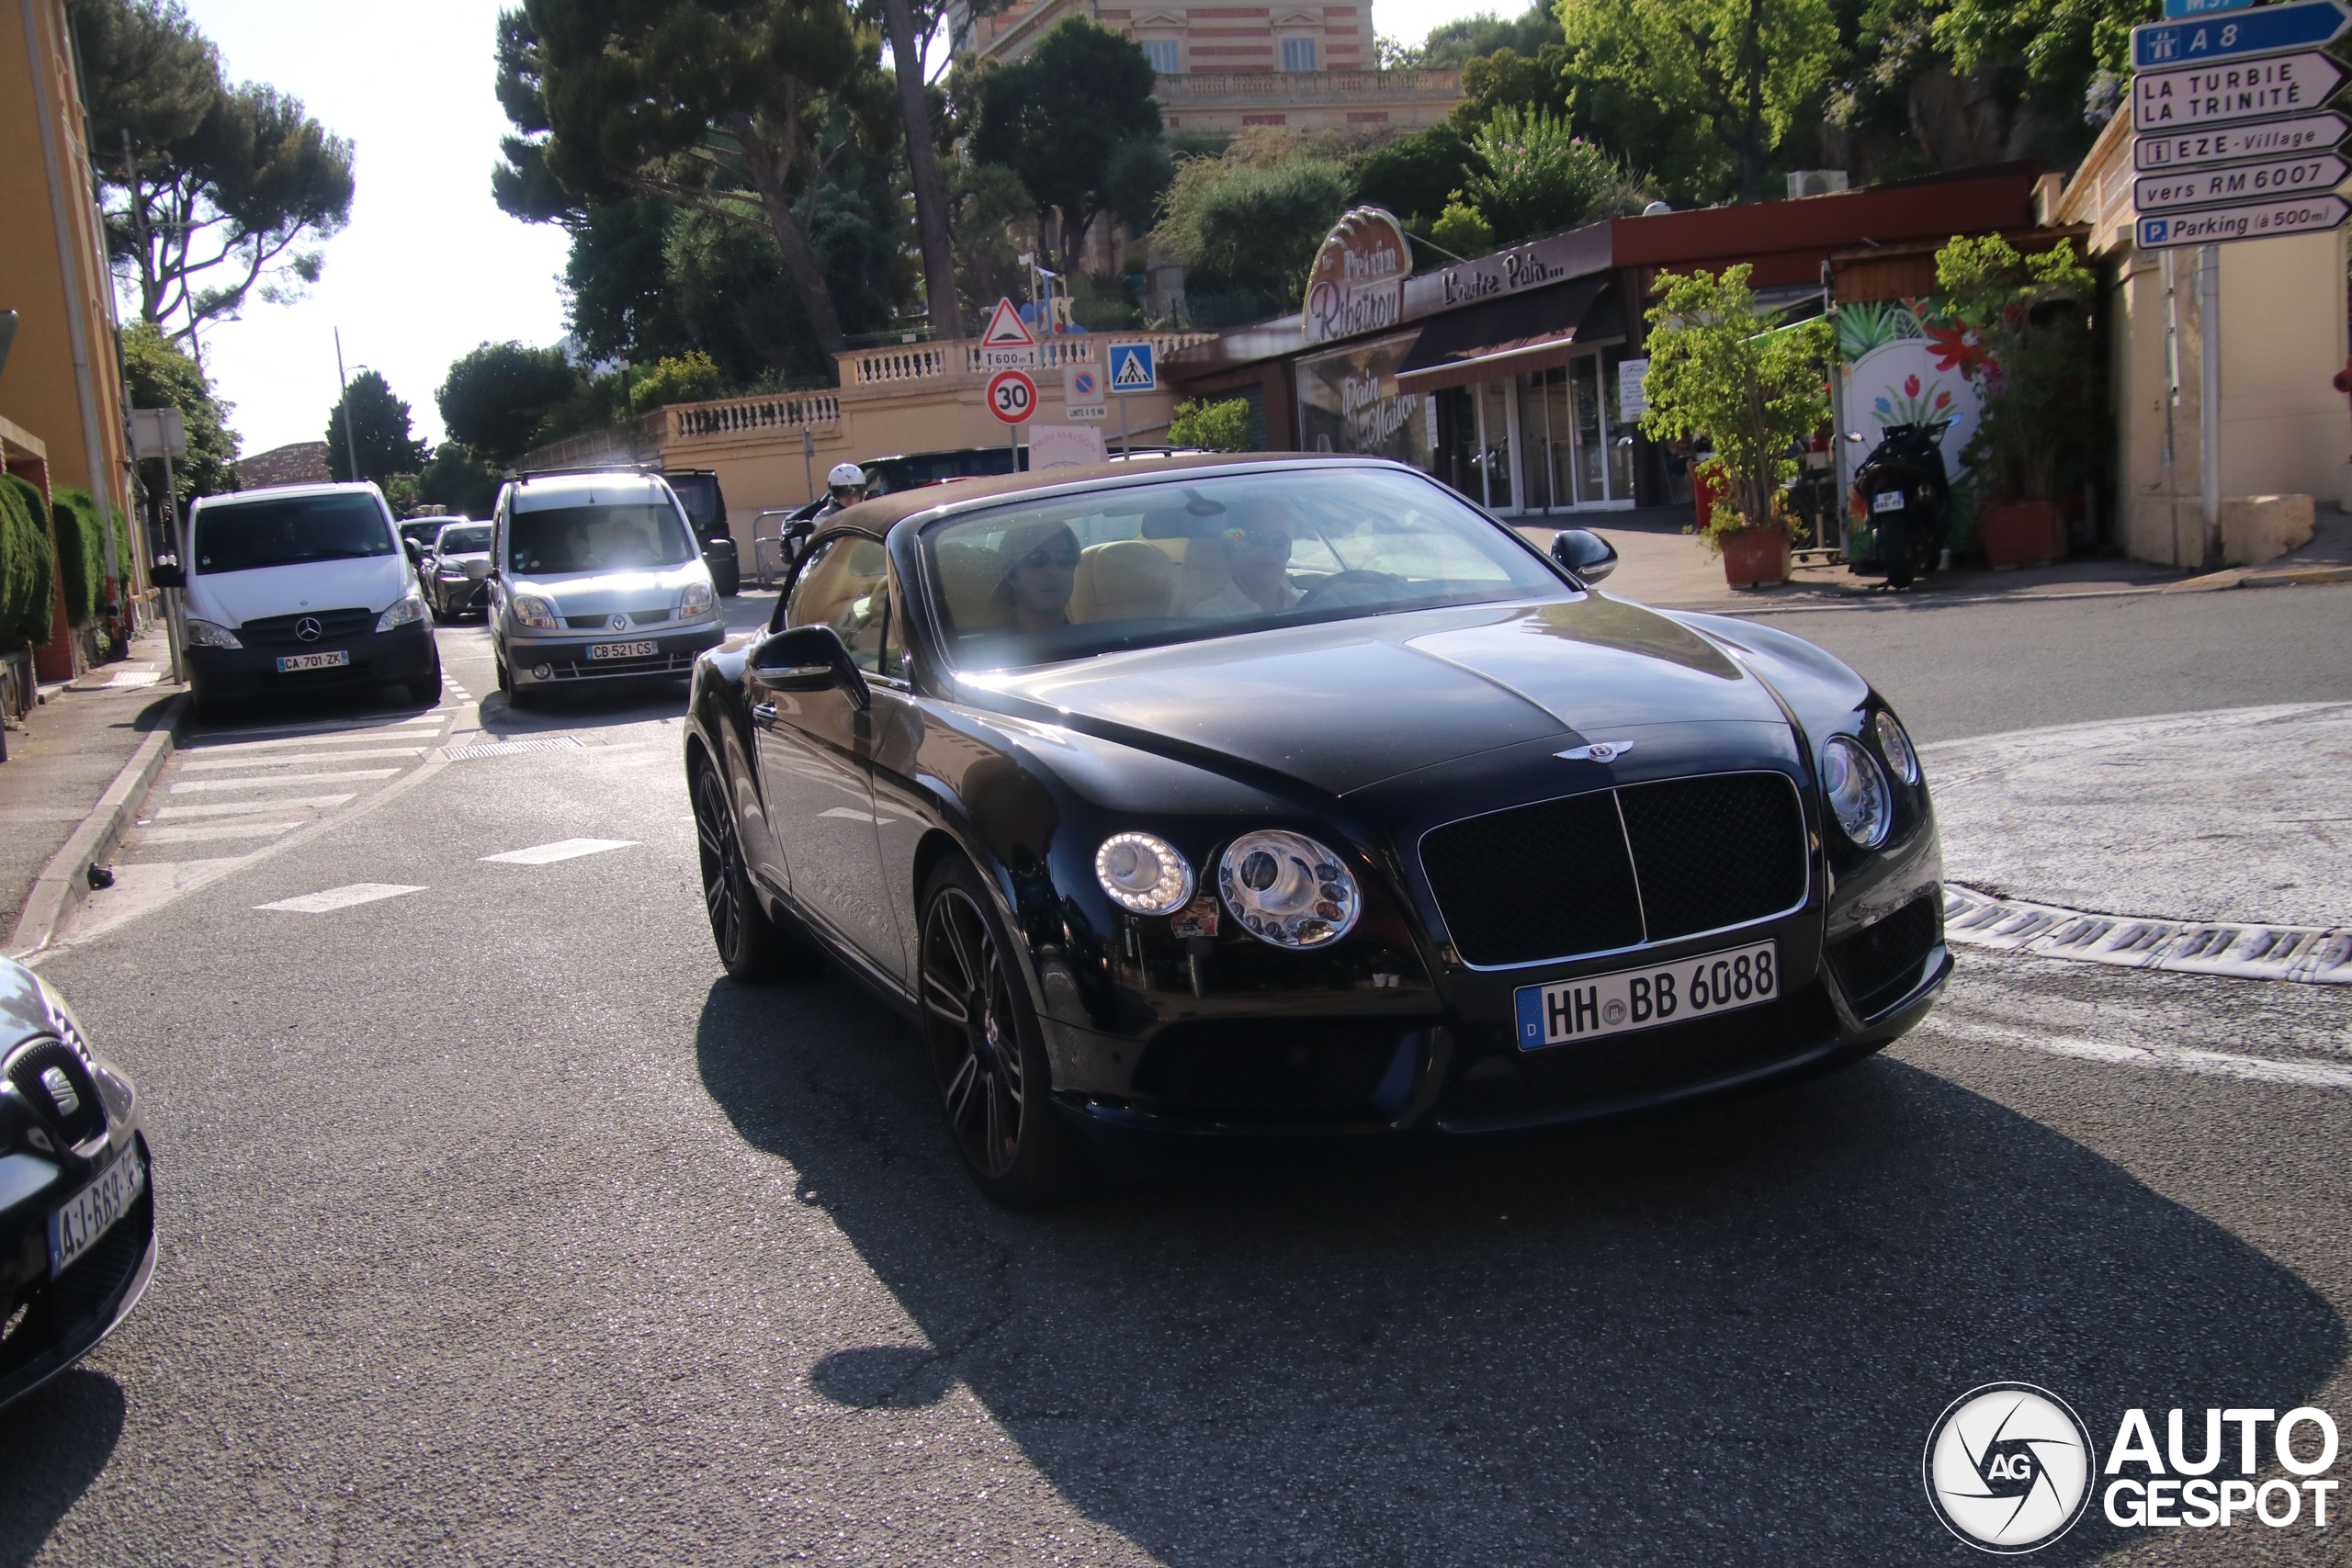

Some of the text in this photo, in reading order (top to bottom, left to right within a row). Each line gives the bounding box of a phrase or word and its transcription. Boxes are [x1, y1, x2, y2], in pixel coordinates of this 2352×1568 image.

[2188, 24, 2238, 52] A 8
[2144, 63, 2292, 100] LA TURBIE
[2144, 82, 2300, 122] LA TRINITÉ
[2148, 164, 2322, 202] vers RM 6007
[2172, 215, 2249, 238] Parking
[1343, 240, 1397, 282] Pétrin
[1442, 272, 1501, 305] L'autre
[995, 354, 1026, 364] 600m
[997, 385, 1028, 410] 30
[1341, 368, 1381, 422] Pain
[1367, 393, 1418, 444] Maison
[1031, 431, 1098, 453] PAIN MAISON
[1547, 986, 1600, 1037] HH
[1629, 972, 1678, 1023] BB
[1690, 950, 1774, 1010] 6088
